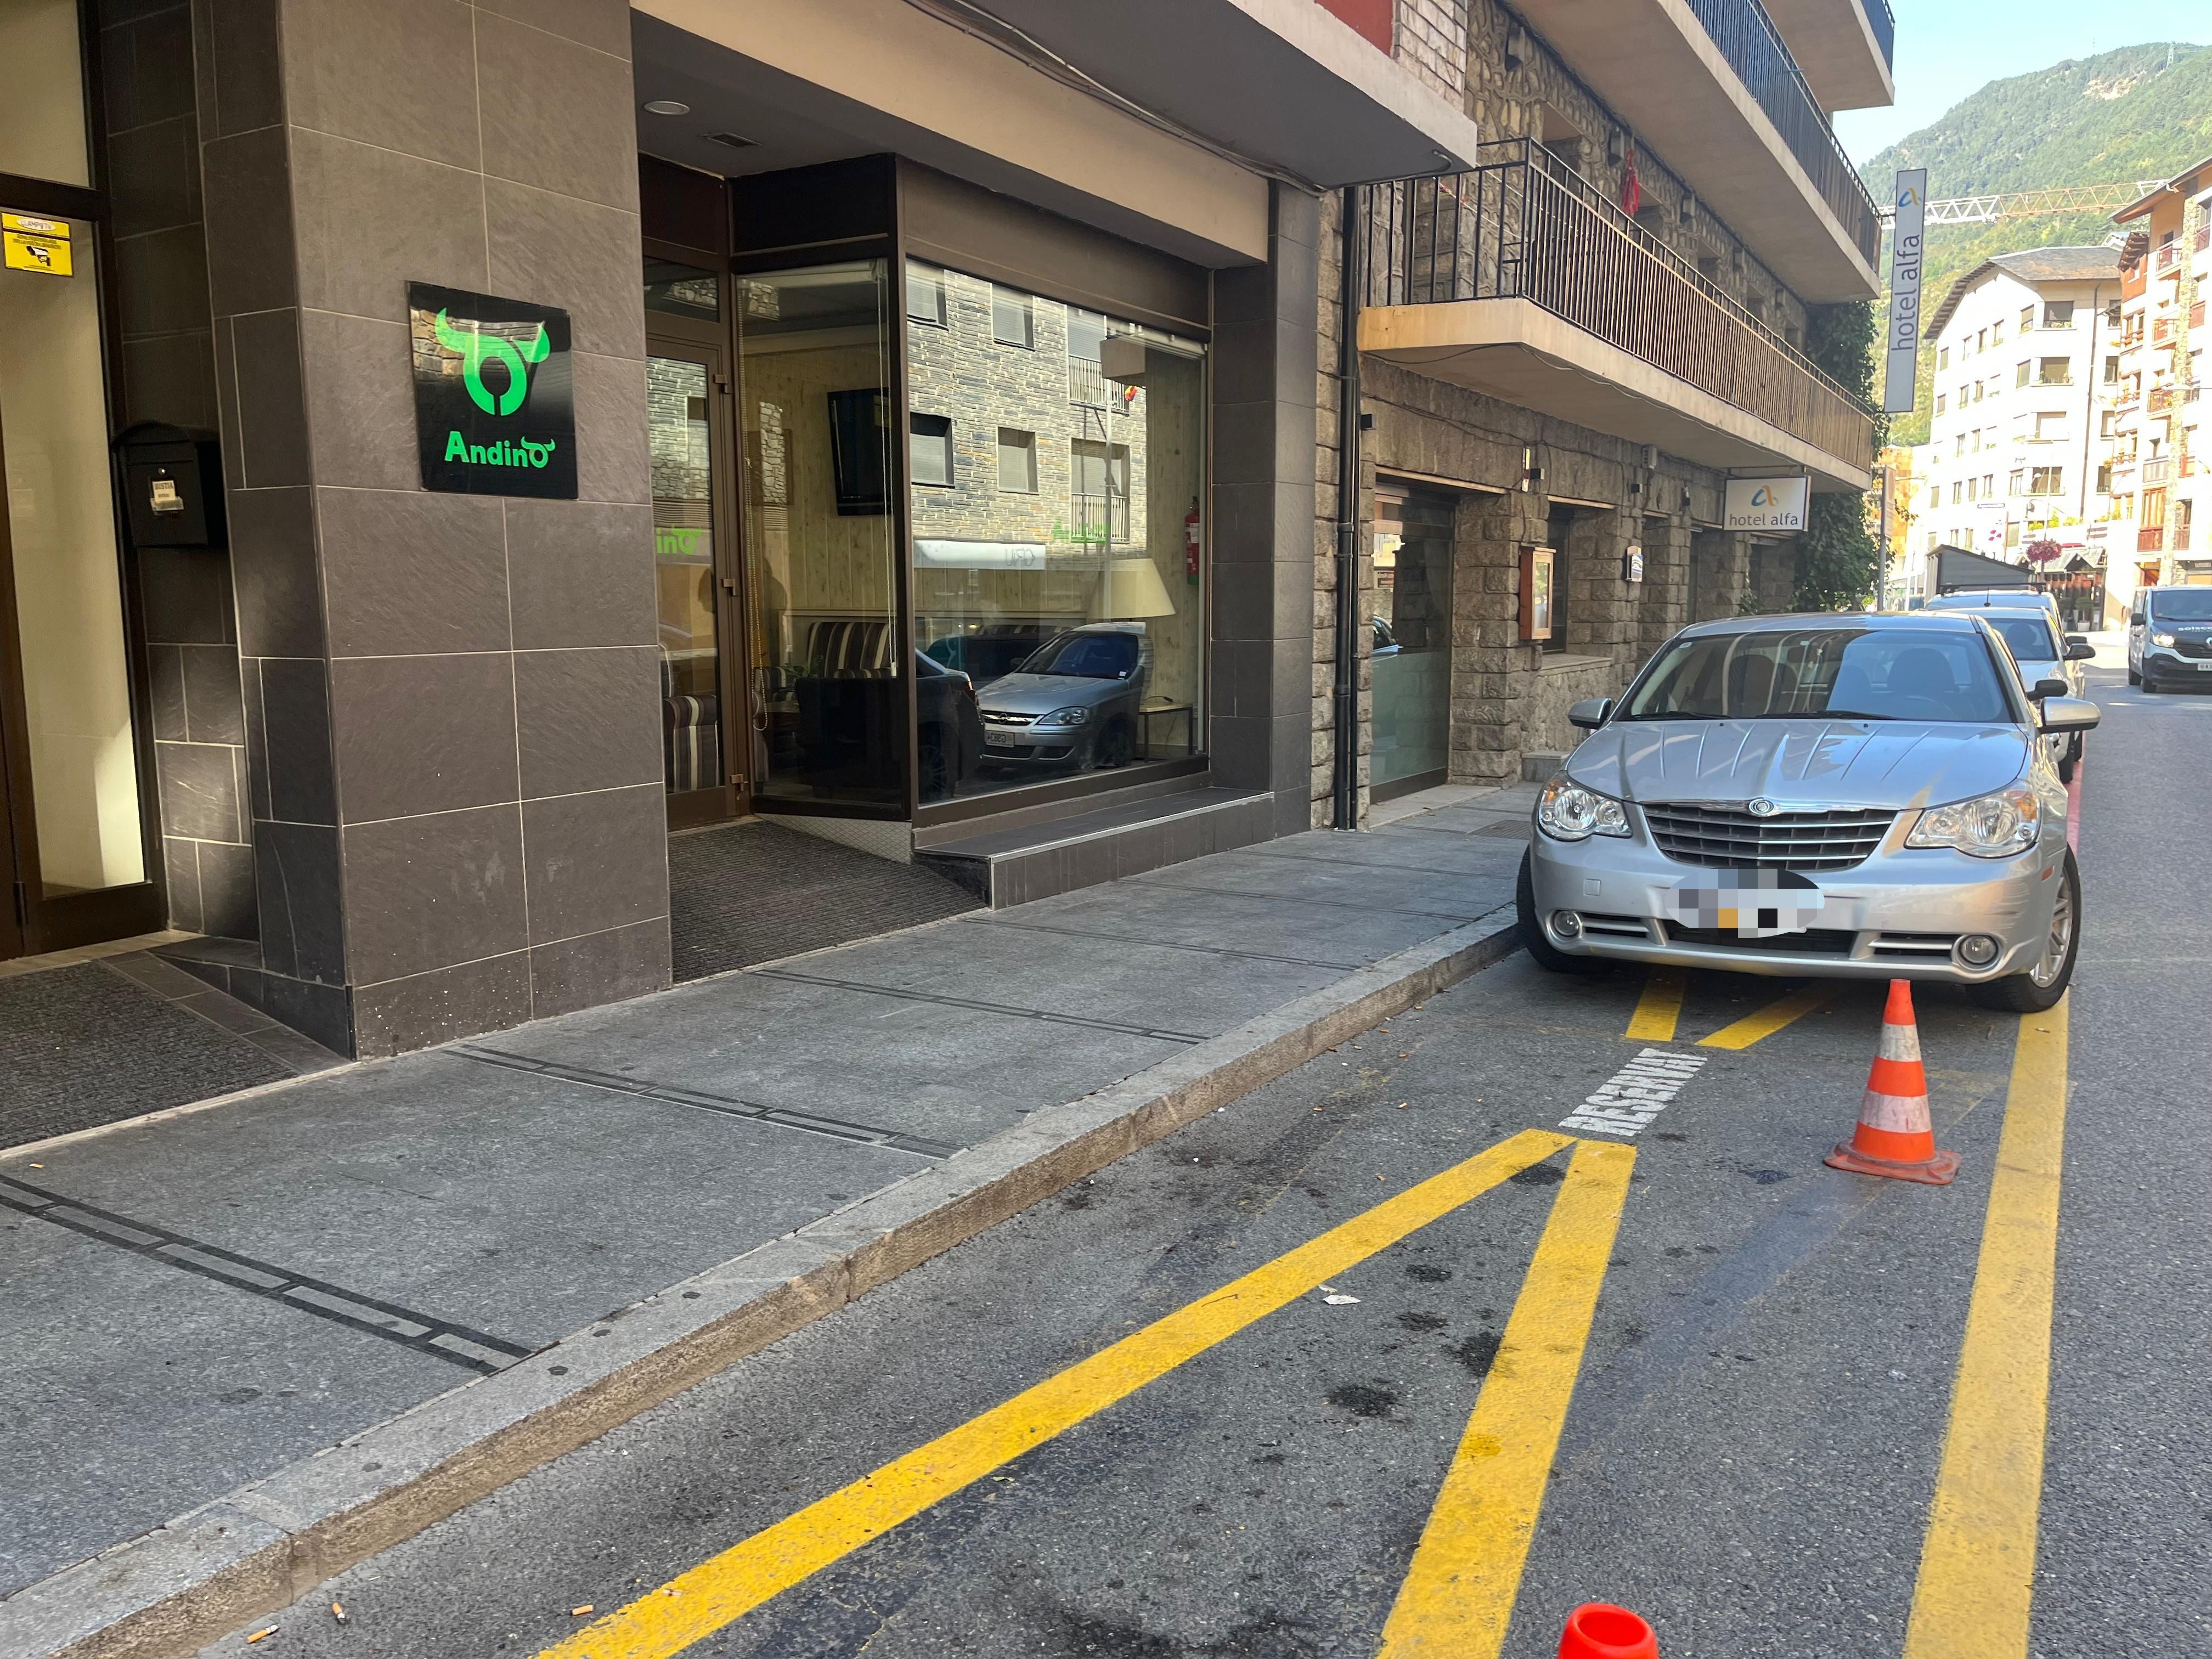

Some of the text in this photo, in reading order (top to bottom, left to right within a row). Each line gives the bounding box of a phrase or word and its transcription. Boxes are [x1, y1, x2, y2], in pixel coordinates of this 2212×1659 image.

[1891, 234, 1920, 351] hotel alfa
[444, 431, 556, 469] Andino
[1730, 513, 1798, 526] hotel alfa
[1558, 1048, 1707, 1136] RESERVAT
